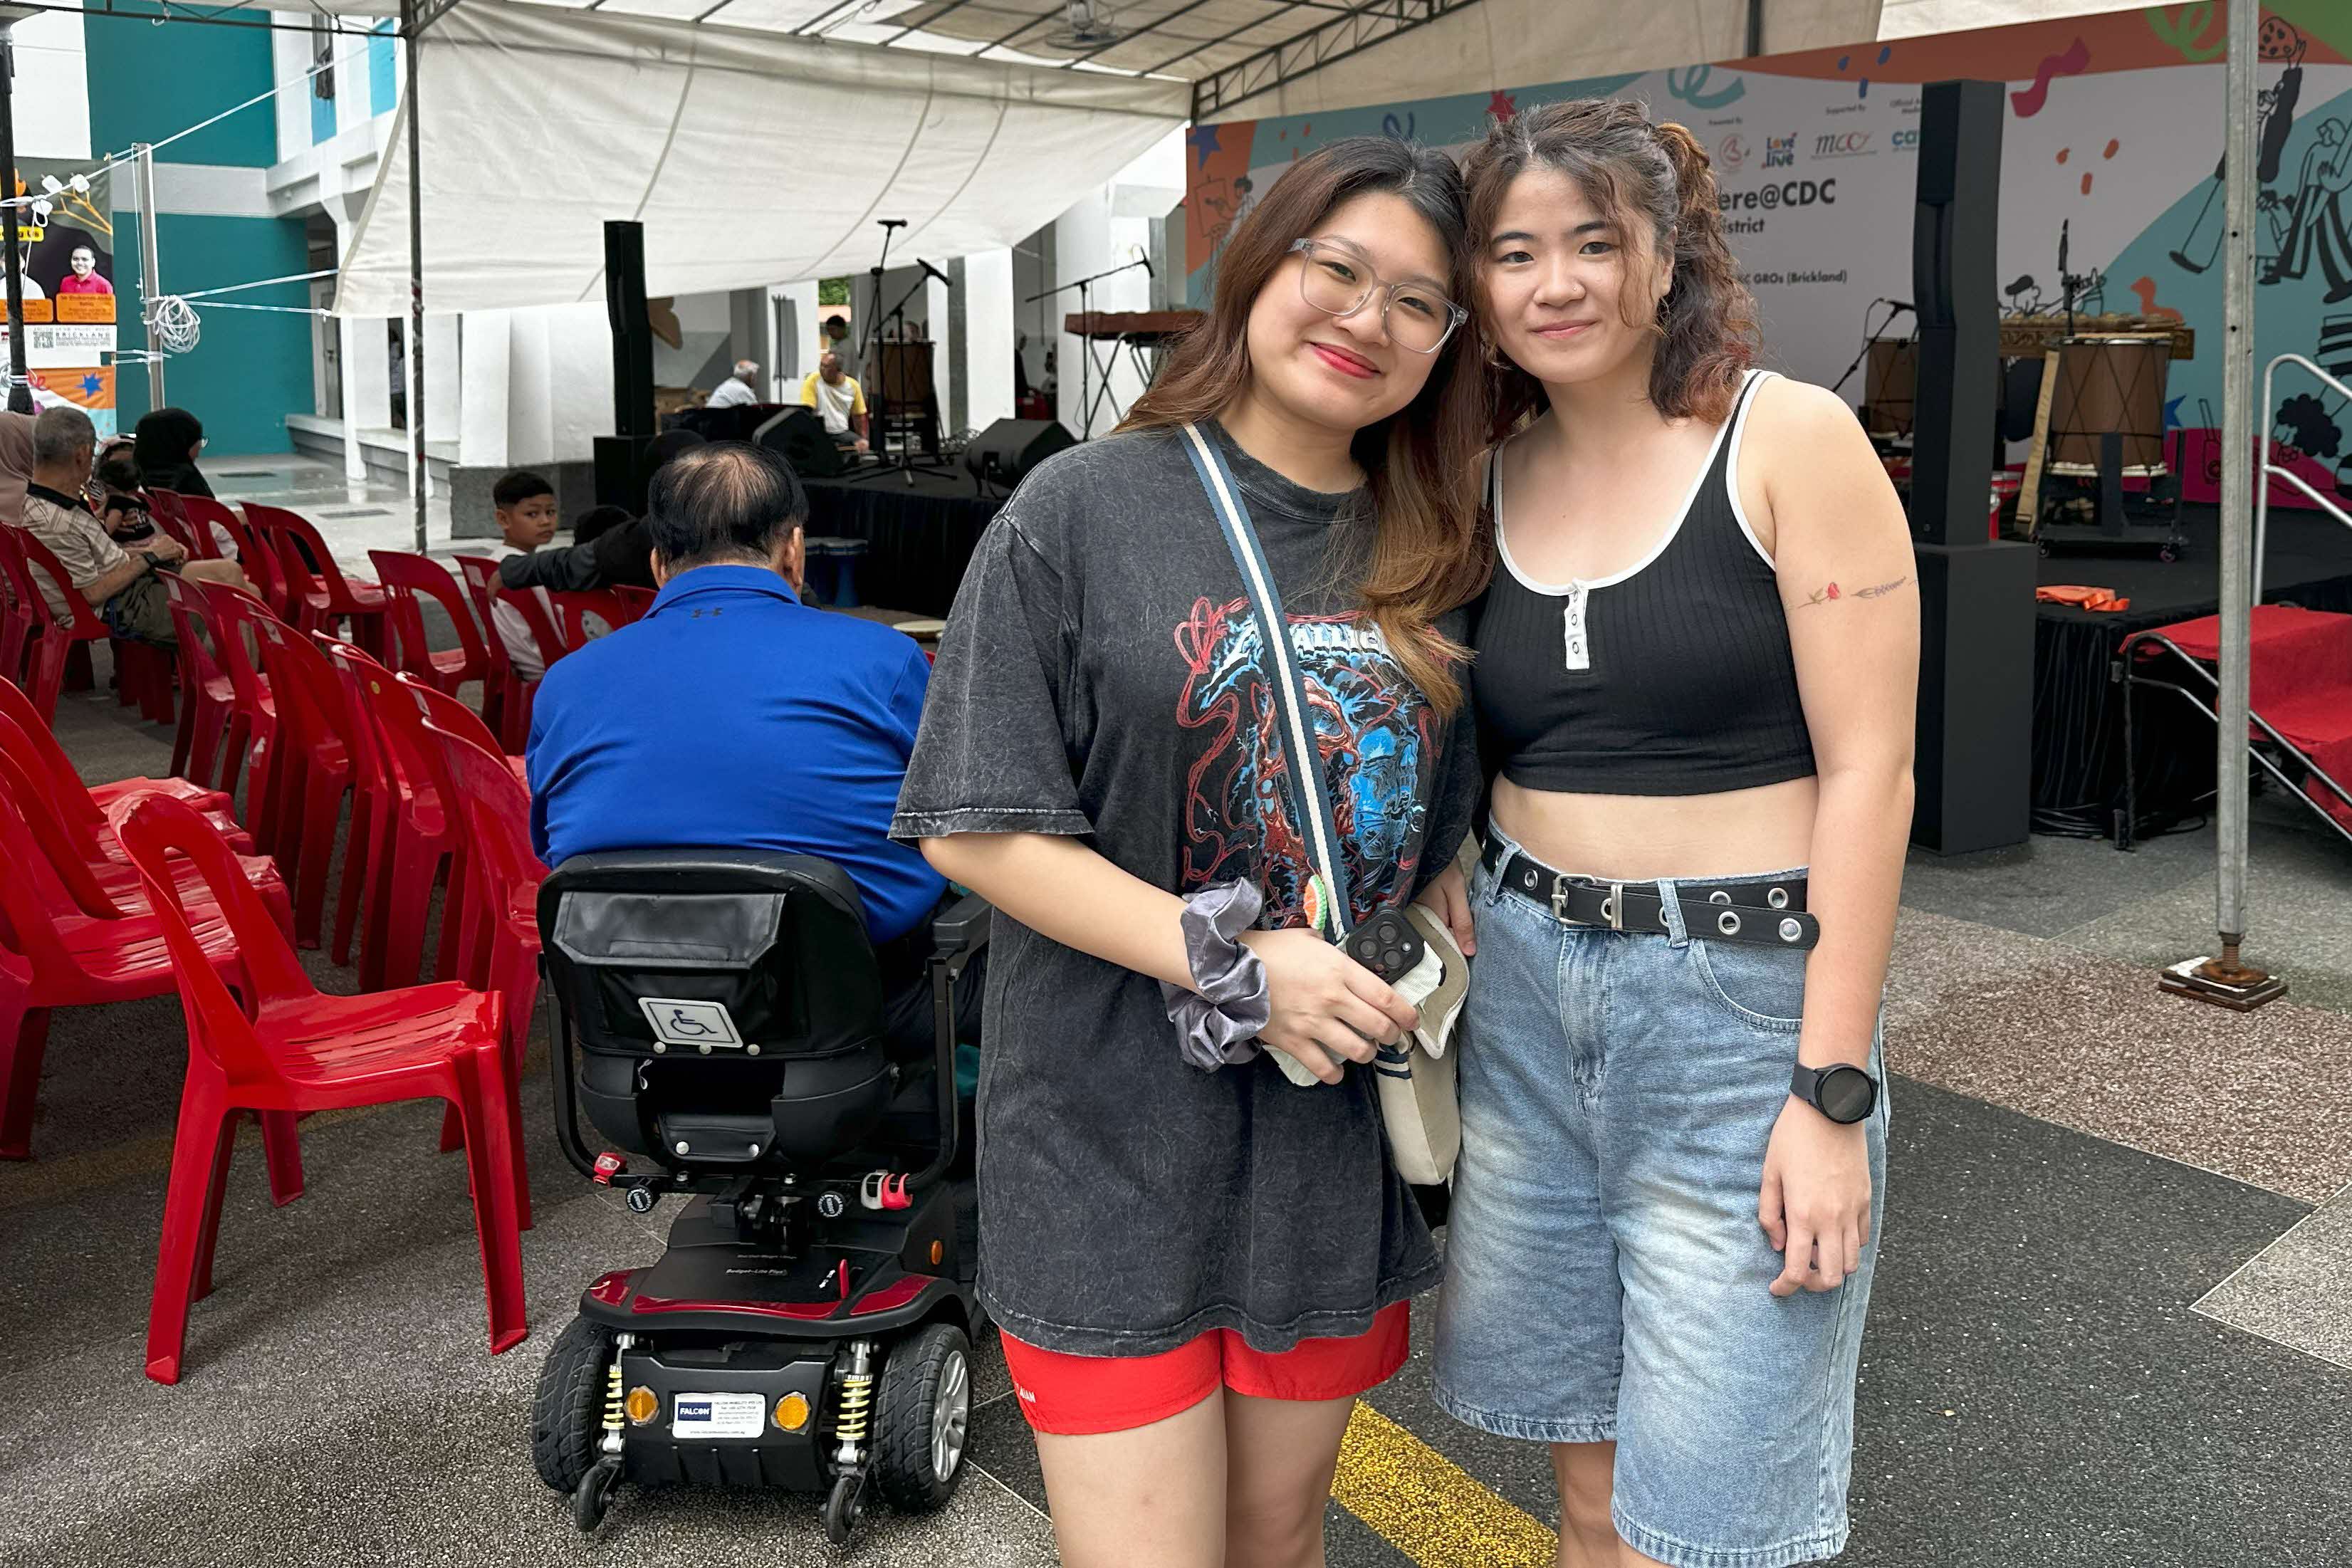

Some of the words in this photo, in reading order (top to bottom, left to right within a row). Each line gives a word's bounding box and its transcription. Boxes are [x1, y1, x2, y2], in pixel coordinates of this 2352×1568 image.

[1891, 131, 1917, 145] ca
[1718, 178, 1836, 211] ere@CDC
[1723, 216, 1765, 234] istrict
[1754, 273, 1784, 284] GROs
[1787, 268, 1847, 285] (Brickland)
[679, 1406, 710, 1416] FALCON
